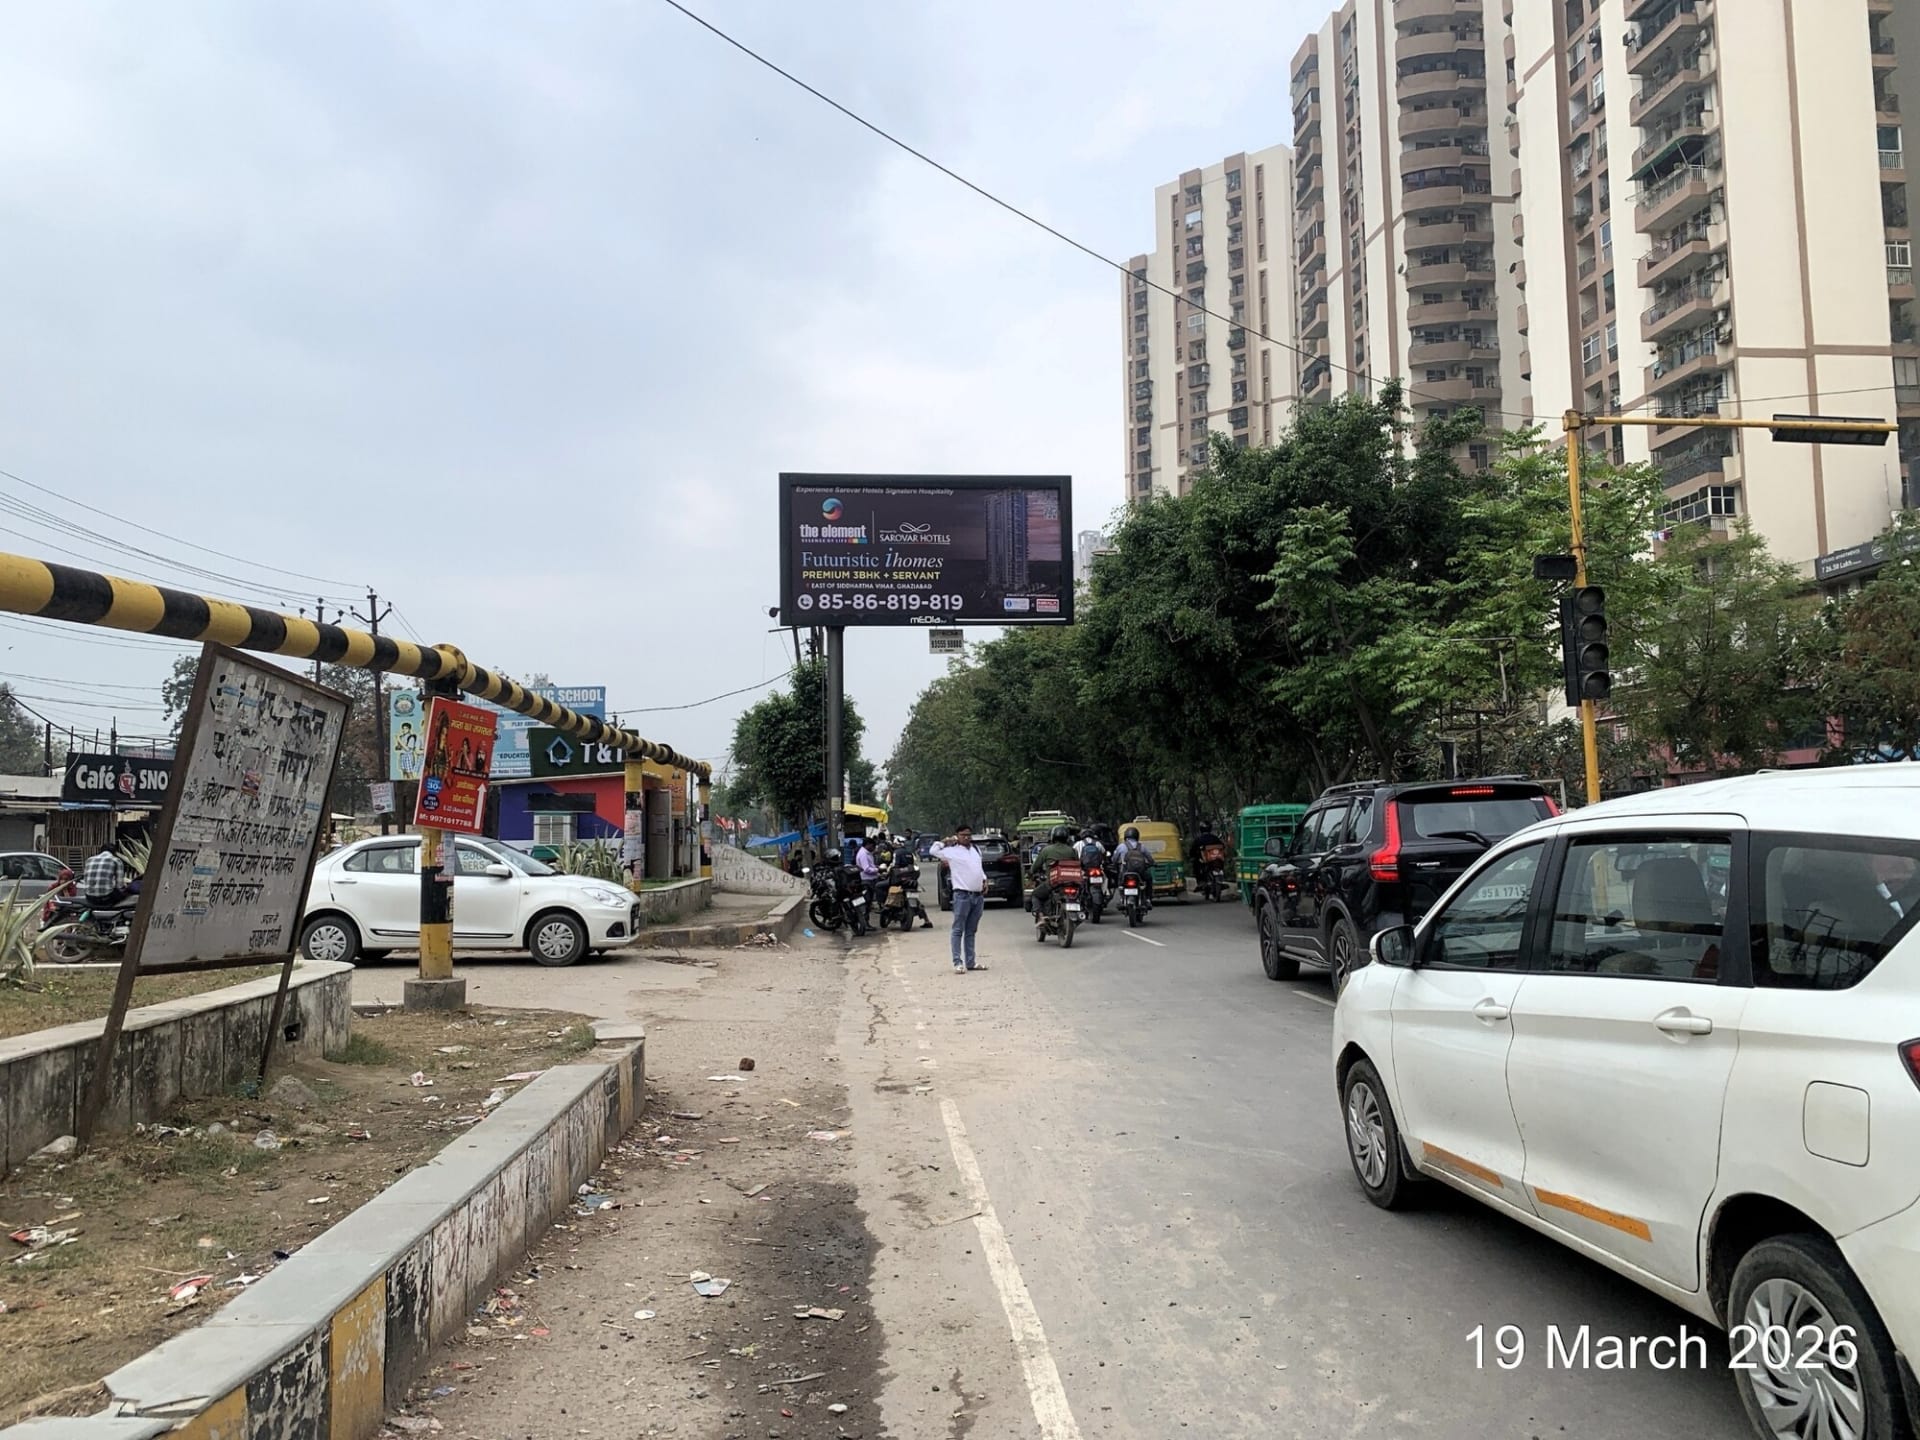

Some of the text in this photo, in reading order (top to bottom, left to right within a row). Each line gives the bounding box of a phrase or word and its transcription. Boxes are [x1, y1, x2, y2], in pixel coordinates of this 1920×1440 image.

[919, 488, 954, 496] Hospitality
[799, 524, 867, 538] the element
[879, 534, 951, 543] SAROVAR HOTELS
[801, 551, 880, 568] Futuristic
[802, 570, 850, 579] PREMIUM
[853, 570, 881, 579] 3BHK
[892, 571, 941, 580] SERVANT
[818, 593, 963, 610] 85-86-819-819
[558, 688, 604, 702] SCHOOL
[75, 764, 172, 791] Café SNO
